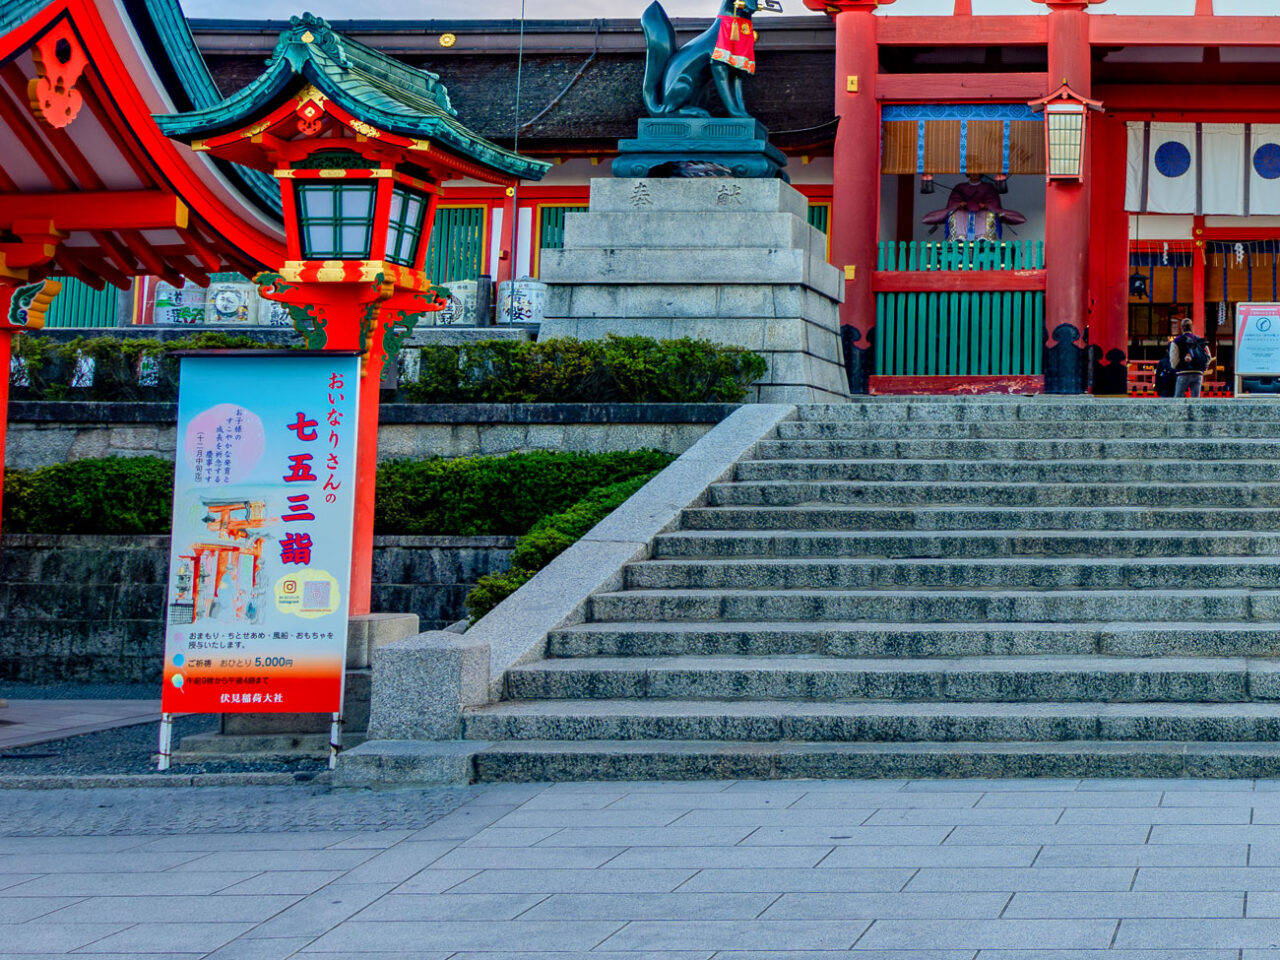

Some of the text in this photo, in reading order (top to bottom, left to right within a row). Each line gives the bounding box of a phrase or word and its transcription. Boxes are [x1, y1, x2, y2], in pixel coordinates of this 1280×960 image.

[234, 408, 243, 440] お子様の
[322, 372, 345, 504] おいなりさんの
[223, 417, 233, 483] すこやかな発育と
[279, 412, 320, 566] 七五三詣
[220, 658, 252, 668] おひとり
[254, 656, 293, 668] 5,000円
[220, 693, 284, 703] 伏見稲荷大社
